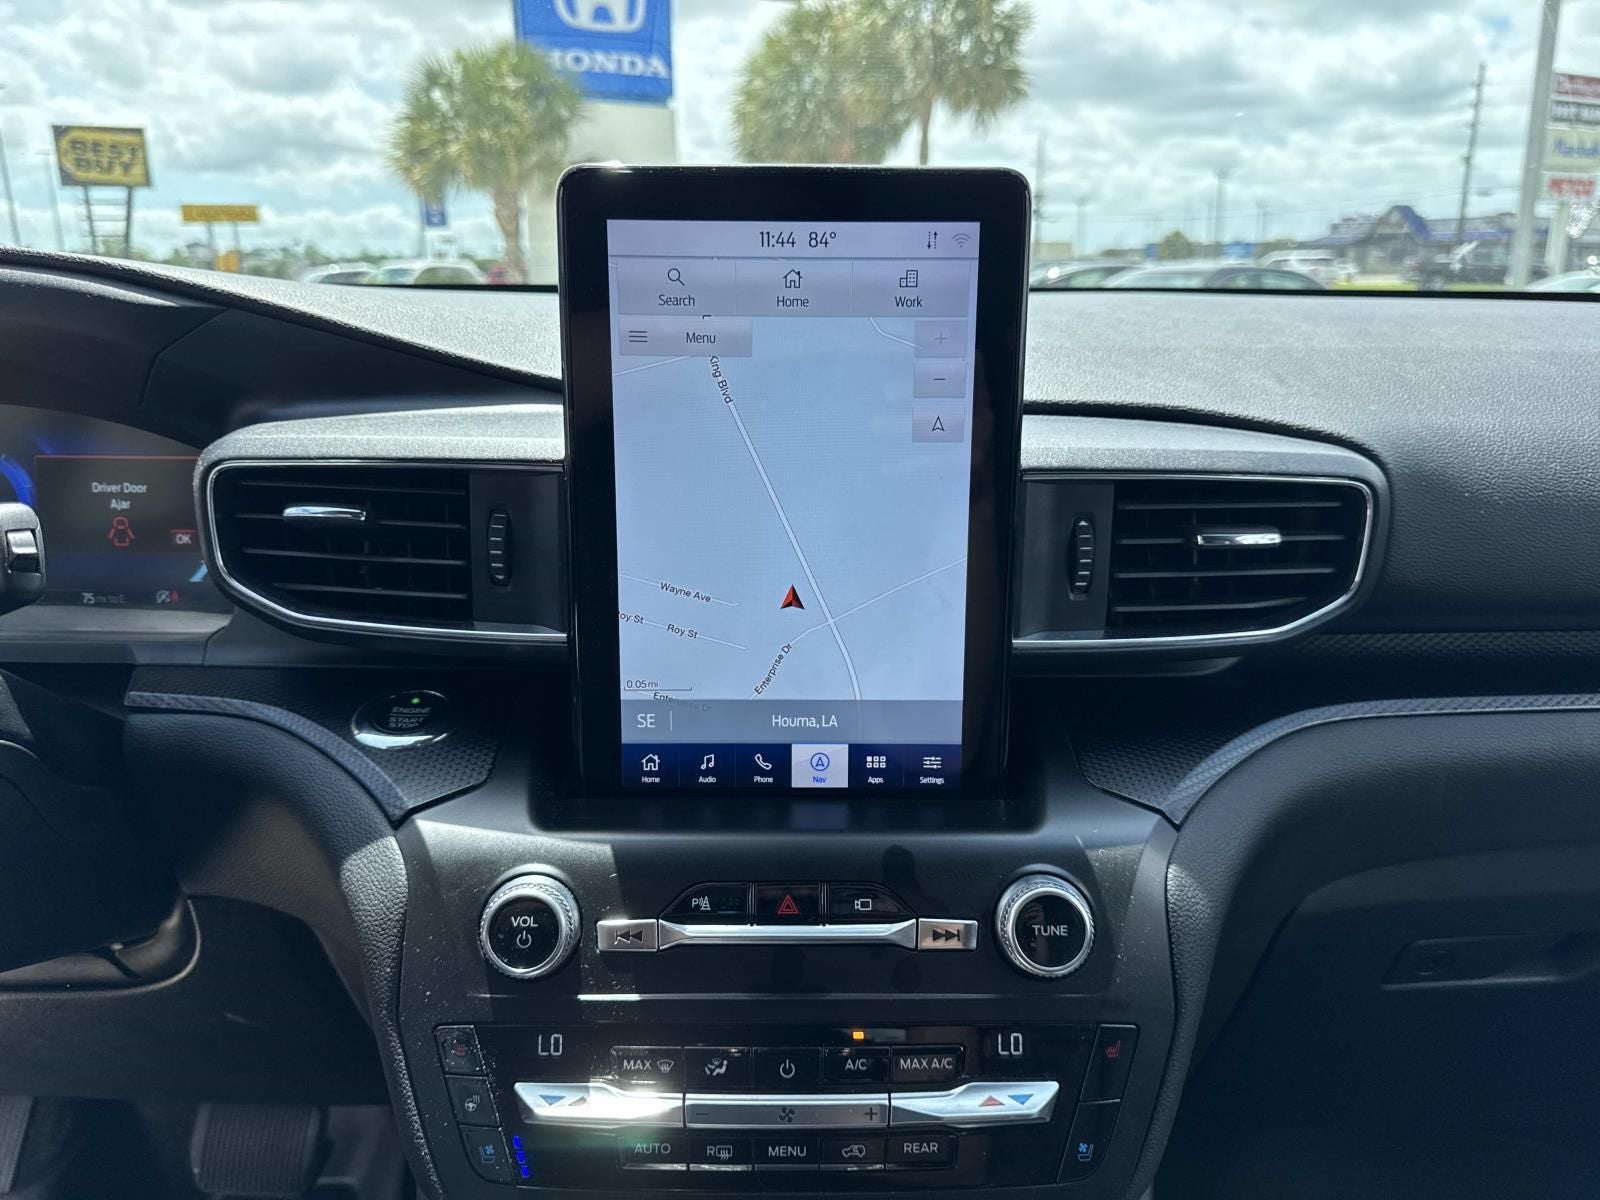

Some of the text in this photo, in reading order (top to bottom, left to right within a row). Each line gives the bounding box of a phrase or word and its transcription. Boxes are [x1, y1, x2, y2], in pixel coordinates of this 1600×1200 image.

[70, 139, 139, 159] BEST
[75, 158, 134, 176] BUY
[759, 231, 837, 248] 11:44 84°
[658, 294, 695, 307] Search
[776, 296, 809, 308] Home
[894, 296, 922, 308] Work
[685, 331, 717, 344] Menu
[717, 379, 734, 404] Blvd
[92, 482, 147, 493] Driver Door
[110, 499, 131, 510] Ajar
[176, 535, 192, 544] OK
[82, 592, 95, 604] 75
[660, 581, 711, 602] Wayne Ave
[619, 612, 644, 624] oy St
[666, 623, 698, 639] Roy St
[754, 643, 793, 694] Enterprise Dr
[391, 706, 431, 714] ENGINE
[637, 713, 656, 728] SE
[772, 714, 838, 729] Houma, LA
[641, 775, 660, 784] Home
[698, 775, 716, 784] Audio
[753, 775, 773, 784] Phone
[812, 775, 826, 784] Nav
[867, 775, 884, 785] Apps
[919, 775, 945, 785] Settings
[510, 915, 539, 928] VOL
[1032, 924, 1069, 938] TUNE
[538, 1033, 563, 1056] LO
[998, 1032, 1023, 1056] LO
[622, 1059, 652, 1072] MAX
[845, 1058, 868, 1071] A/C
[900, 1057, 953, 1070] MAX A/C
[634, 1143, 672, 1155] AUTO
[768, 1145, 807, 1157] MENU
[903, 1142, 939, 1154] REAR
